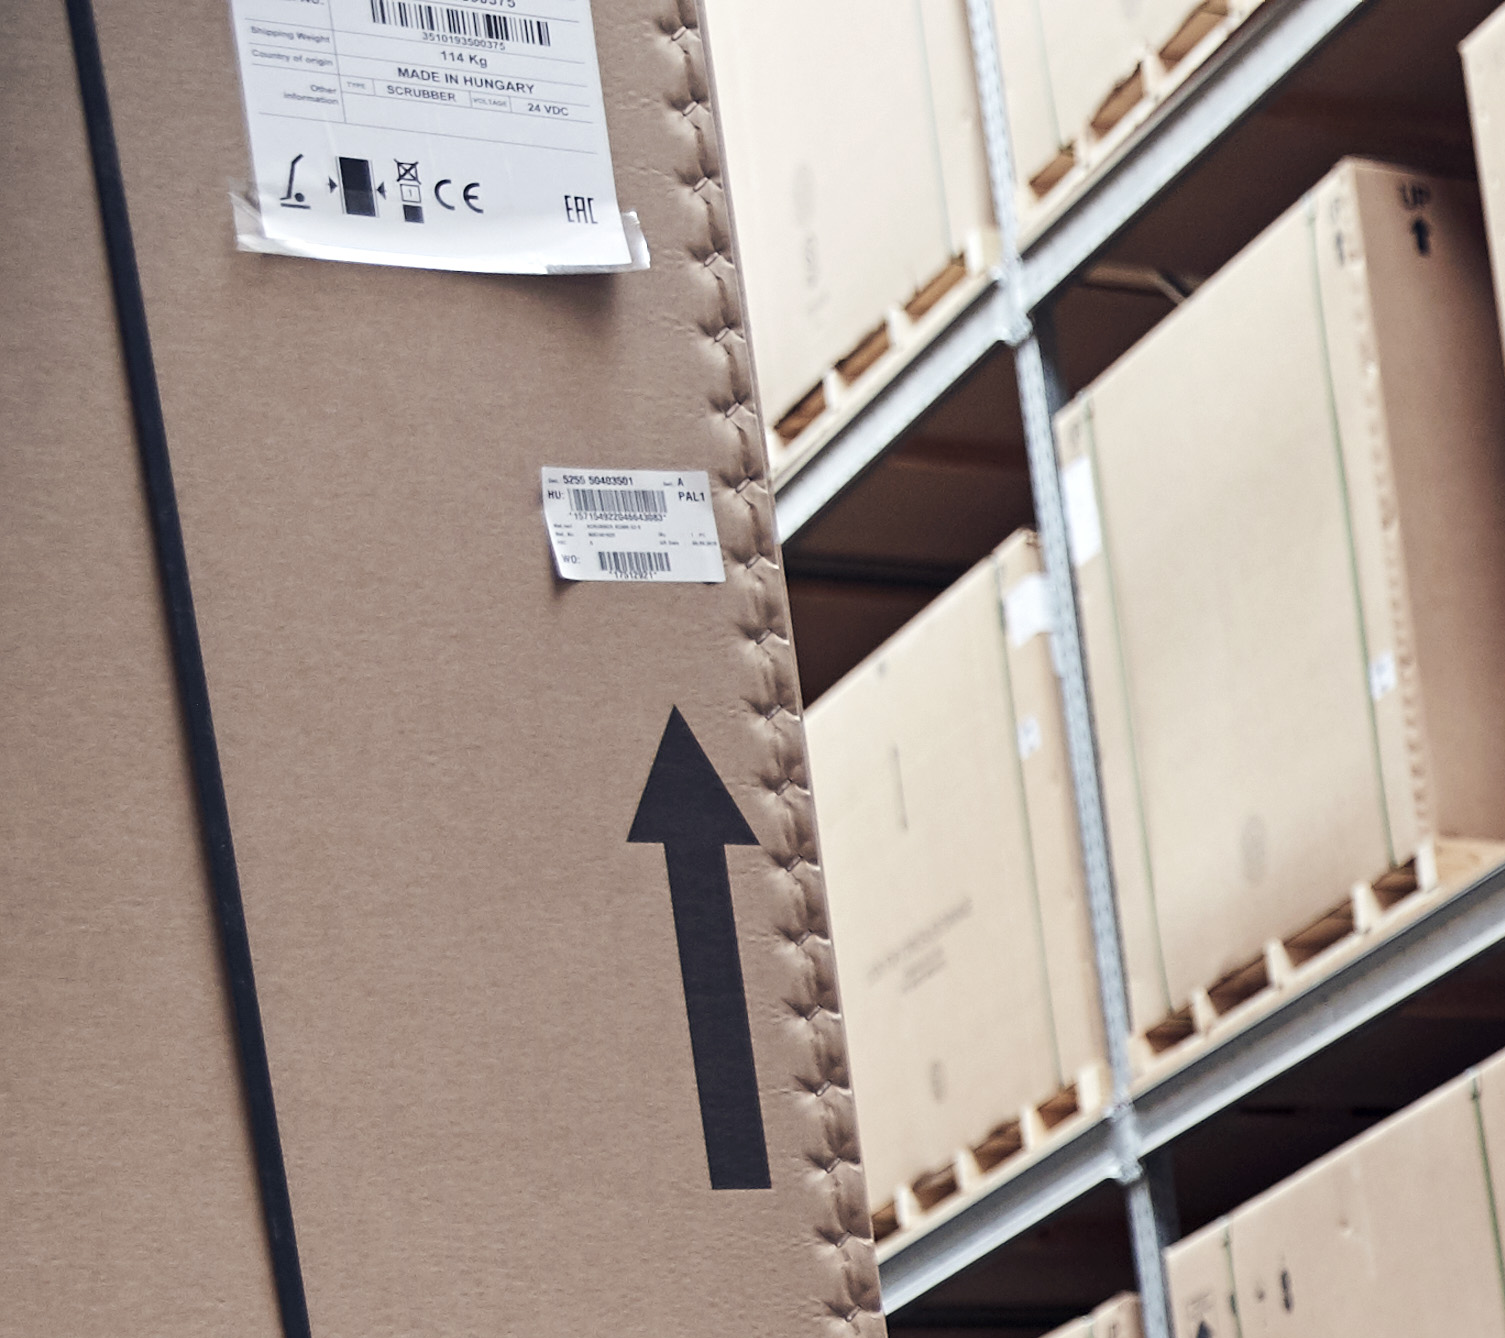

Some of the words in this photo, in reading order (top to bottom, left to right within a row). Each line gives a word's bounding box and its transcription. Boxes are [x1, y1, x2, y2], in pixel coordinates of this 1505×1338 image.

[421, 30, 506, 51] 3510193500375
[440, 50, 465, 64] 114
[469, 53, 489, 69] Kg
[397, 67, 441, 83] MADE
[444, 71, 460, 85] IN
[463, 74, 535, 95] HUNGARY
[386, 85, 457, 102] SCRUBBER
[527, 102, 542, 113] 24
[543, 104, 570, 117] VDC
[678, 491, 706, 501] PAL1
